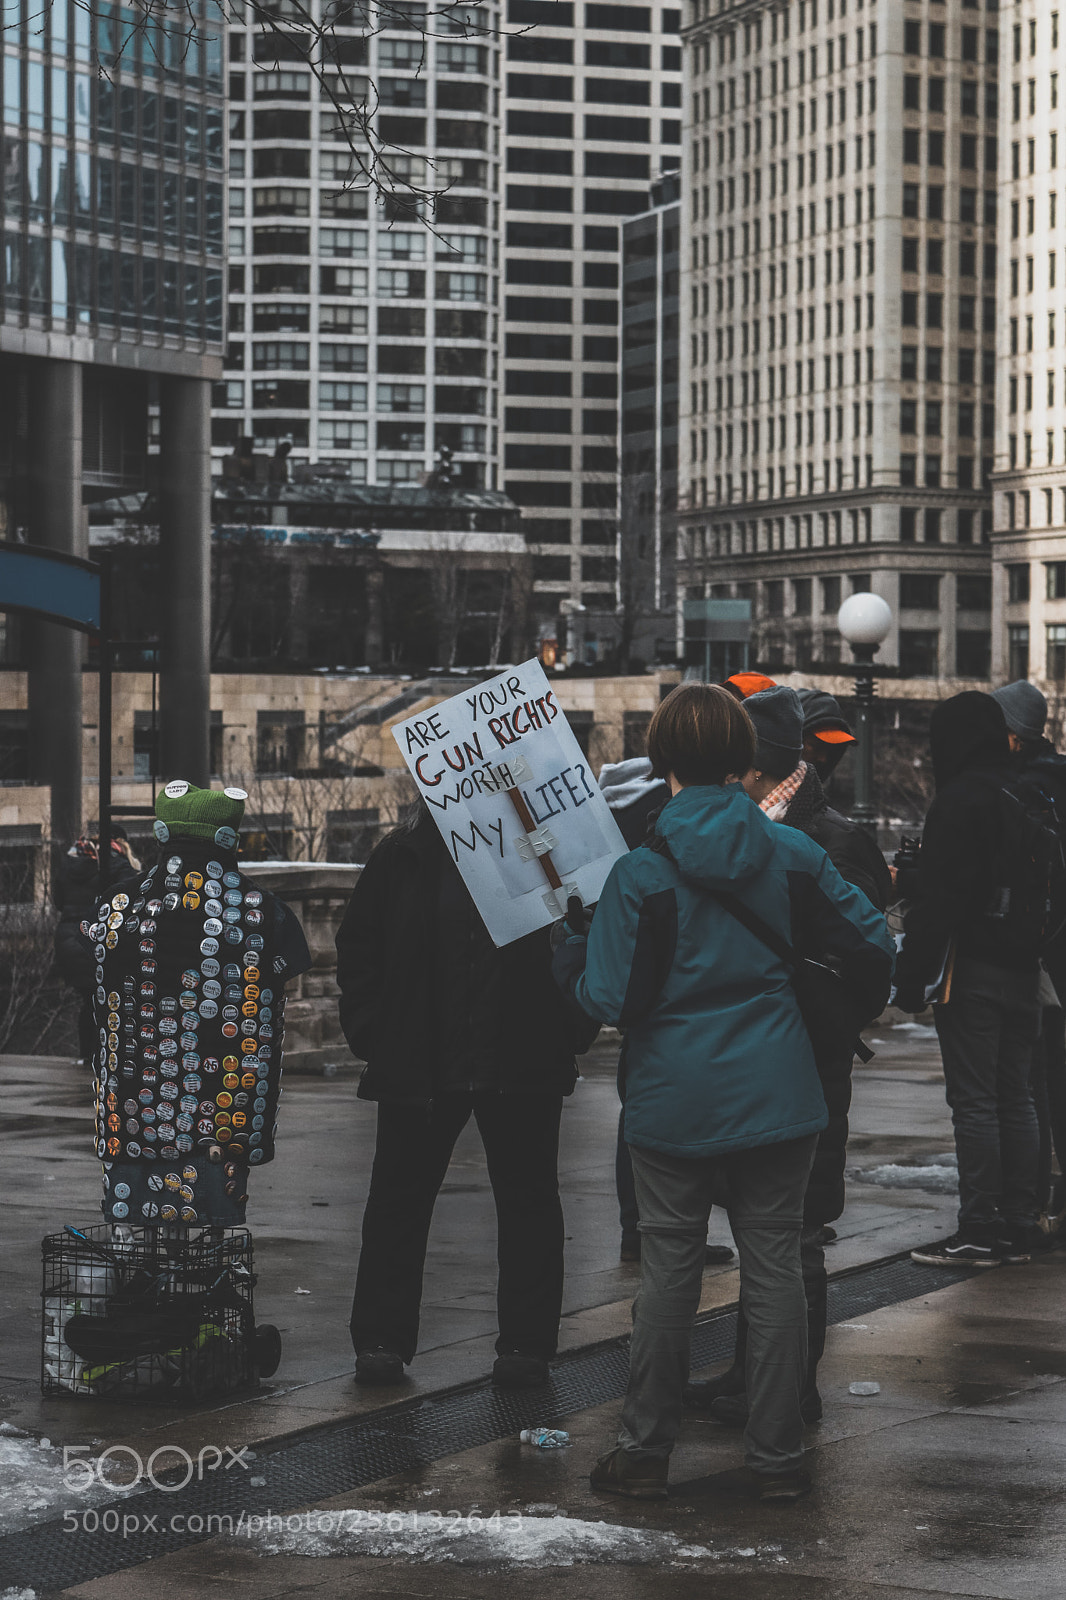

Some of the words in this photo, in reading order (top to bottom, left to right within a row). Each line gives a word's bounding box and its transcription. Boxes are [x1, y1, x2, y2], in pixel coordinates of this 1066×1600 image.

[405, 712, 450, 754] ARE
[466, 676, 526, 721] YOUR
[415, 732, 484, 786] GUN
[488, 691, 558, 750] RIGHTS
[425, 761, 516, 811] WORTH
[451, 818, 504, 863] MY
[523, 763, 595, 825] LIFE?
